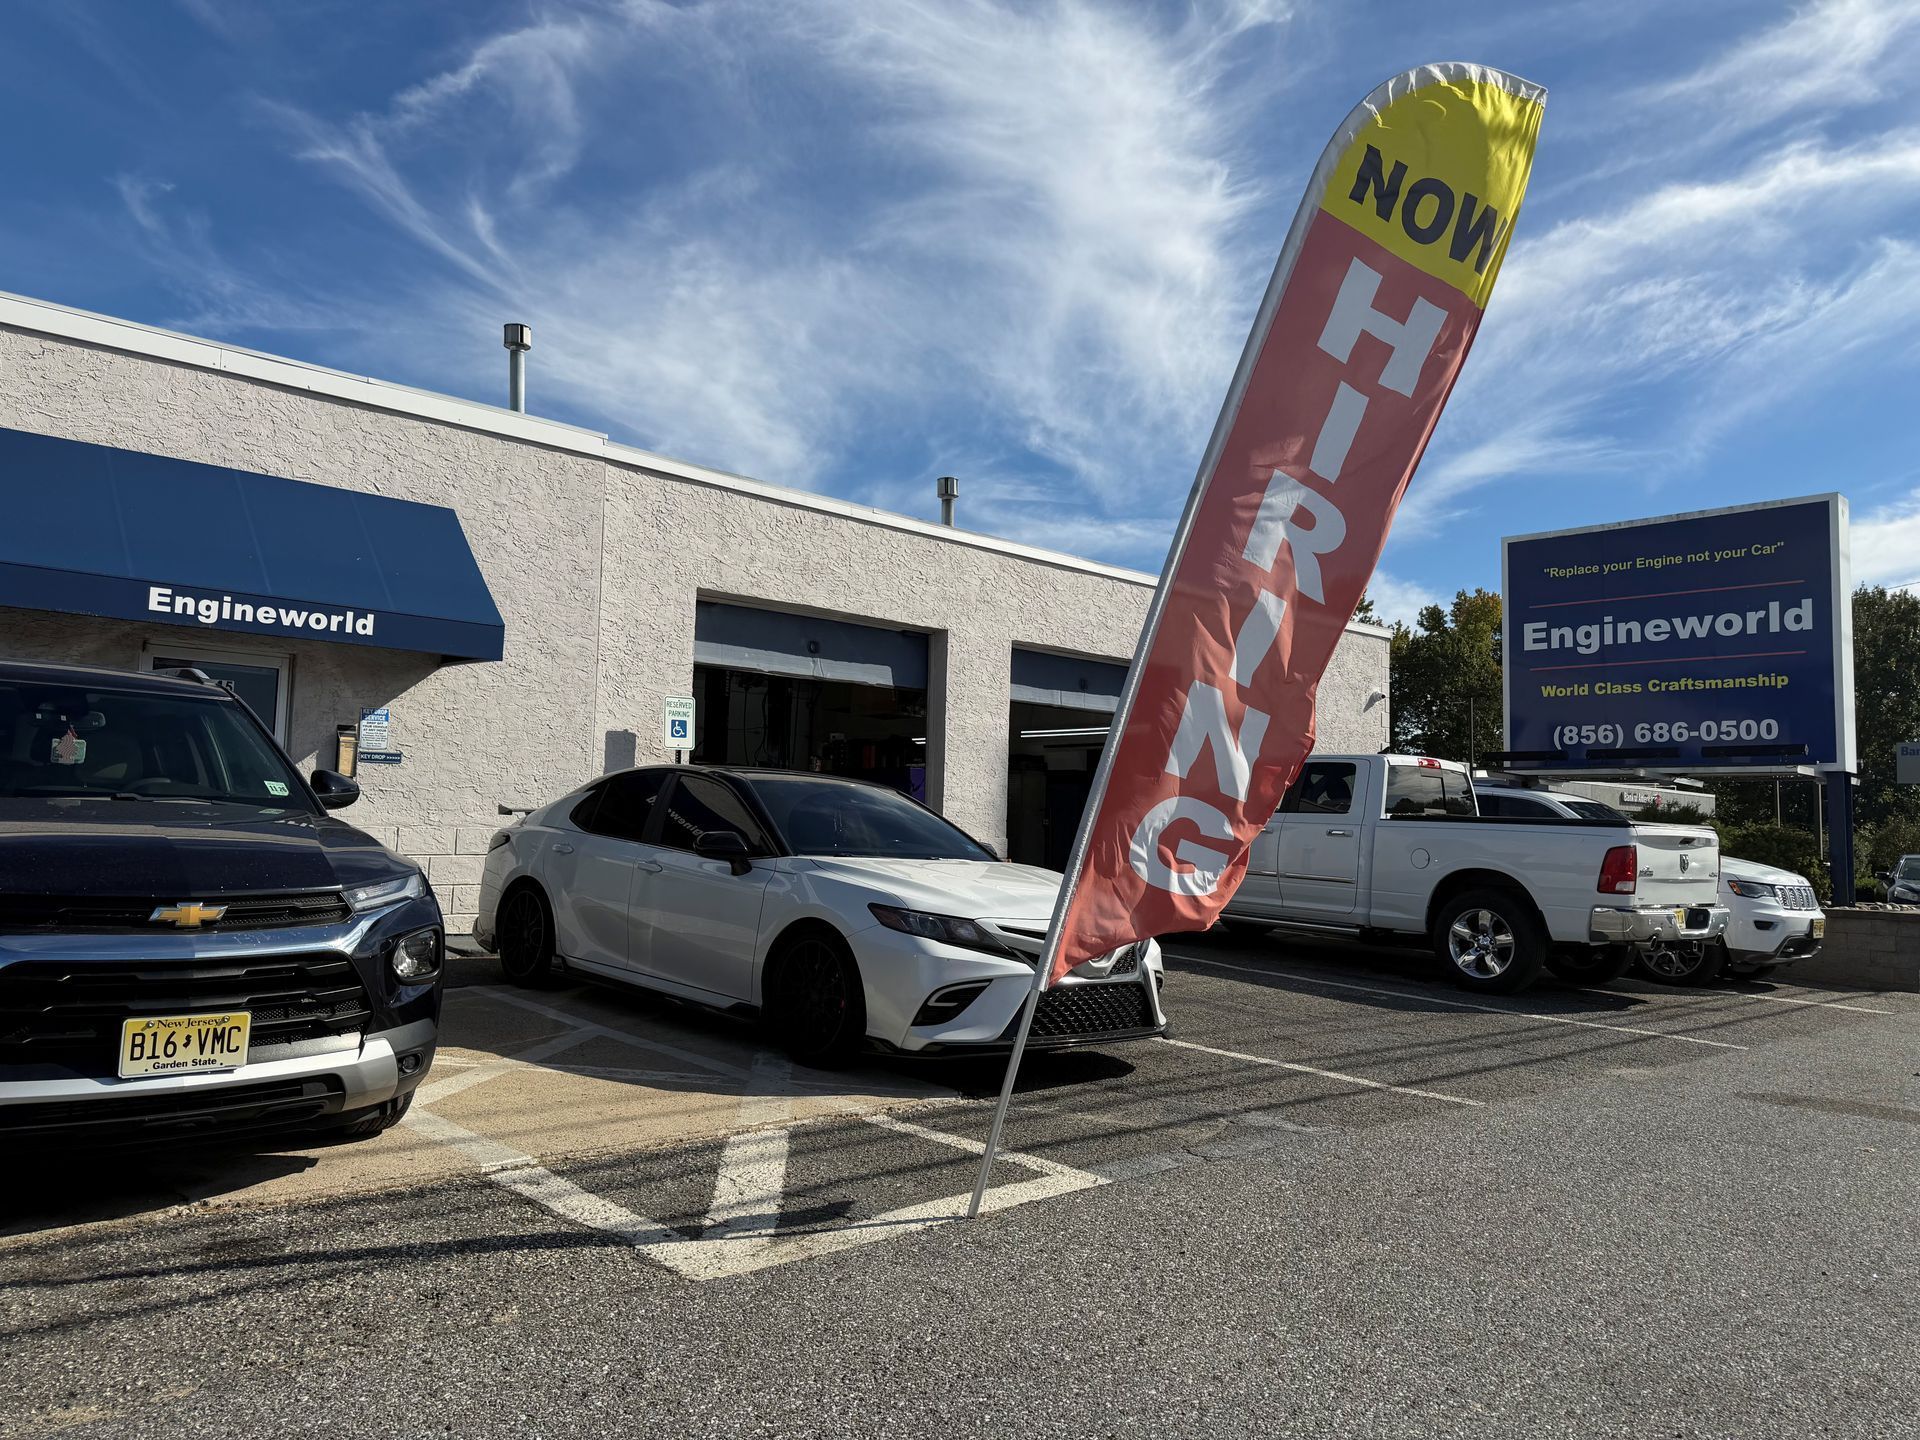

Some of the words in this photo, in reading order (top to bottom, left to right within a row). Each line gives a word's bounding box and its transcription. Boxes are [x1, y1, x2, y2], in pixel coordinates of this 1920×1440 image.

[1349, 143, 1509, 277] NOW
[1129, 256, 1450, 897] HIRING
[1543, 564, 1600, 578] "Replace
[1603, 560, 1632, 575] your
[1636, 555, 1683, 569] Engine
[1687, 550, 1710, 563] not
[1714, 548, 1748, 562] your
[1751, 541, 1785, 556] Car"
[148, 586, 375, 636] Engineworld
[1523, 598, 1813, 655] Engineworld
[1541, 684, 1589, 698] World
[1594, 680, 1642, 696] Class
[1647, 672, 1789, 692] Craftsmanship
[666, 700, 693, 710] RESERVED
[668, 709, 690, 718] PARKING
[1553, 723, 1625, 750] (856)
[1634, 718, 1780, 743] 686-0500
[157, 1019, 184, 1029] New
[184, 1017, 221, 1029] Jersey
[130, 1031, 178, 1062] B16
[197, 1026, 242, 1056] VMC
[152, 1060, 188, 1071] Garden
[191, 1058, 217, 1067] State
